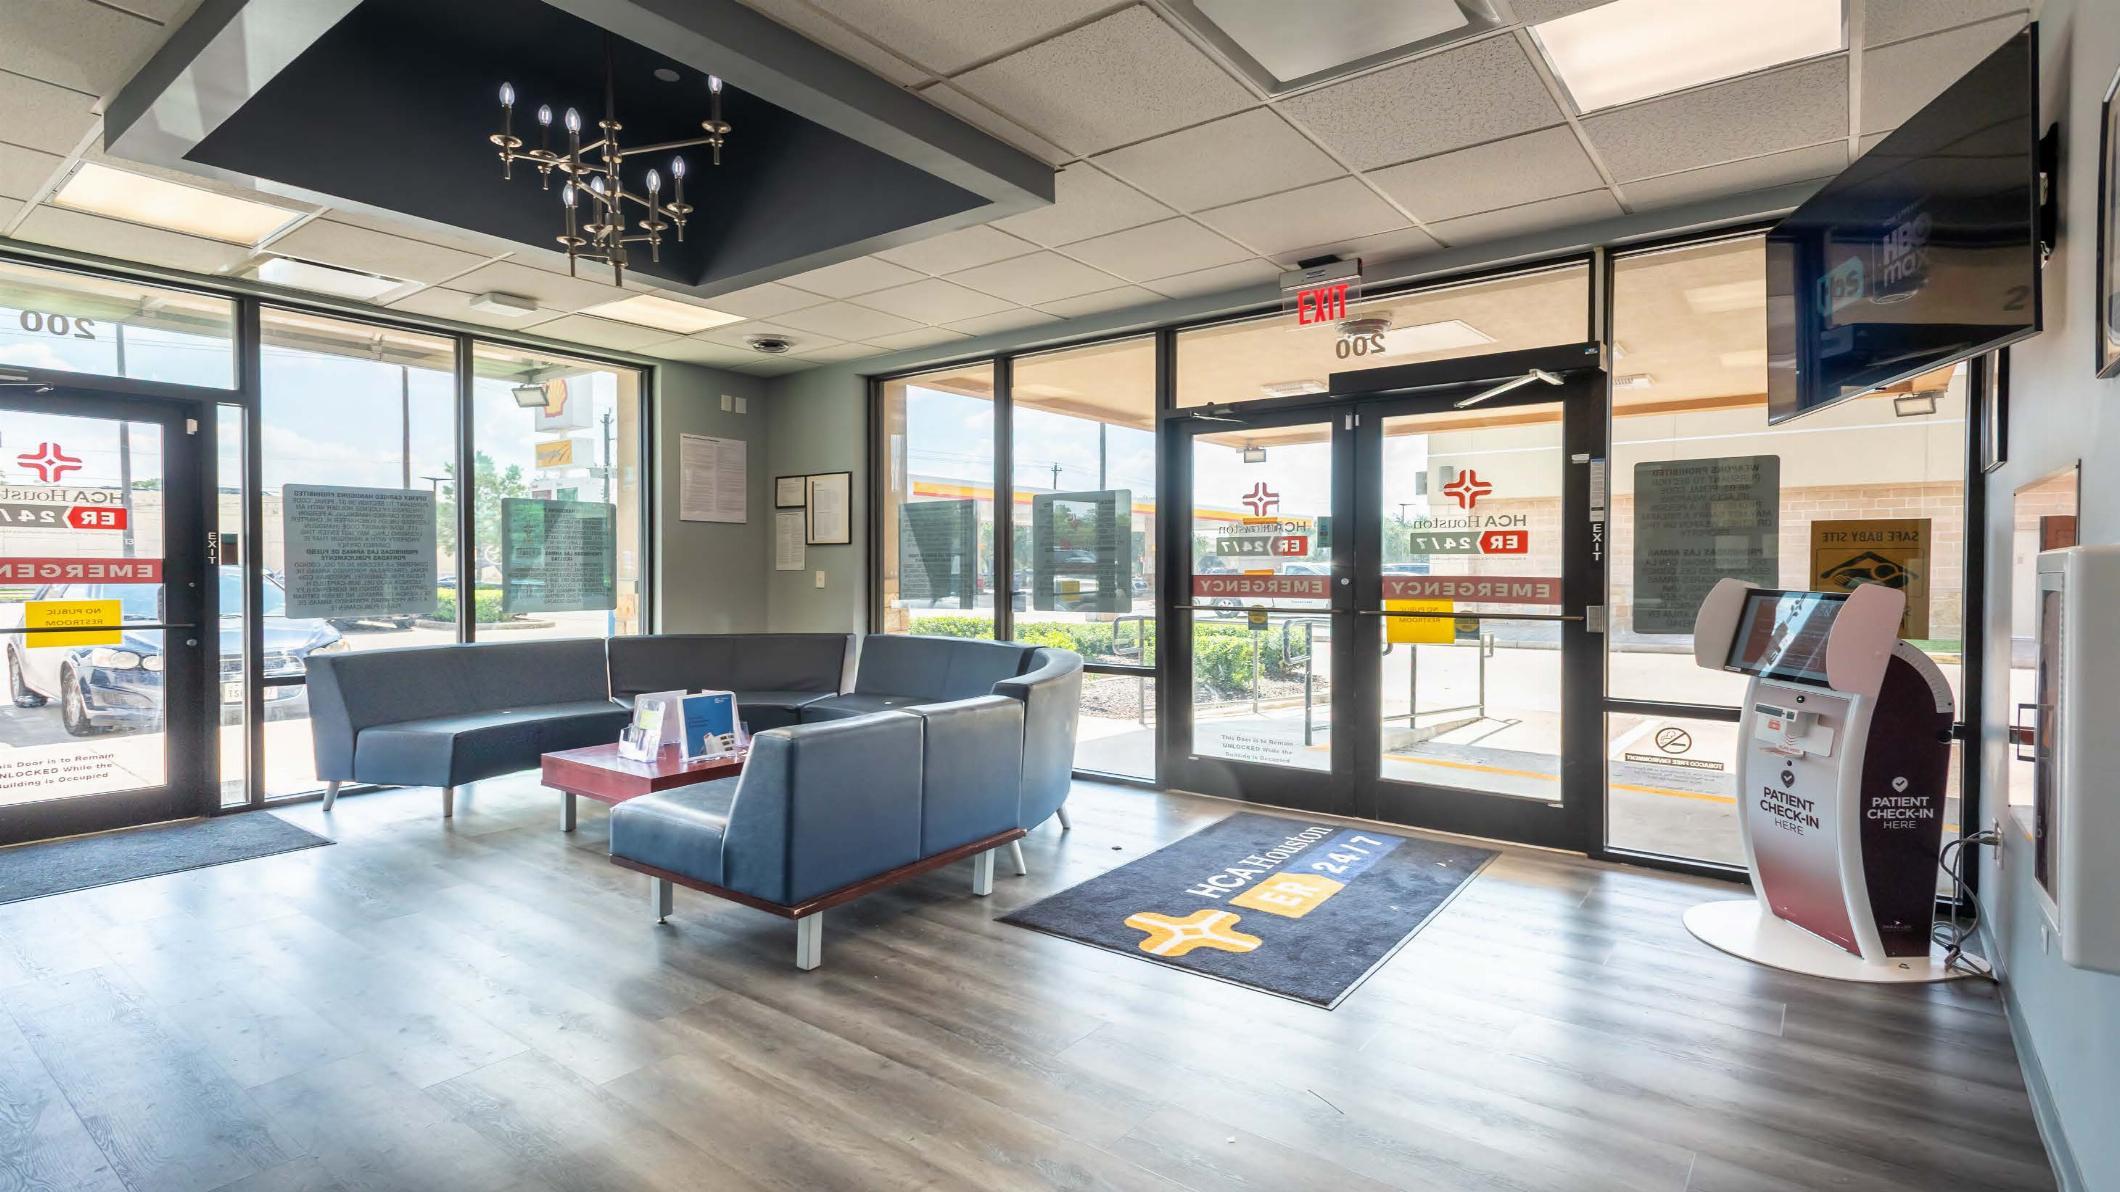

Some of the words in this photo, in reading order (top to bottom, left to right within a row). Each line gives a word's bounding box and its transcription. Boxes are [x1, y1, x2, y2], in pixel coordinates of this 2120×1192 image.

[1884, 212, 1933, 257] HBO
[1297, 283, 1350, 326] EXIT
[208, 531, 217, 565] EXIT
[1592, 523, 1603, 561] EXIT
[17, 760, 43, 768] Door
[74, 753, 115, 762] Remain
[63, 764, 93, 773] While
[59, 772, 110, 783] Occupied
[1764, 786, 1815, 813] PATIENT
[1872, 796, 1930, 807] PATIENT
[1760, 799, 1820, 830] CHECK-IN
[1775, 817, 1805, 836] HERE
[1867, 808, 1934, 819] CHECK-IN
[1883, 820, 1917, 829] HERE
[1186, 867, 1266, 899] HCA
[1237, 826, 1334, 870] Houston
[1257, 881, 1322, 907] ER
[1312, 835, 1384, 874] 24/7
